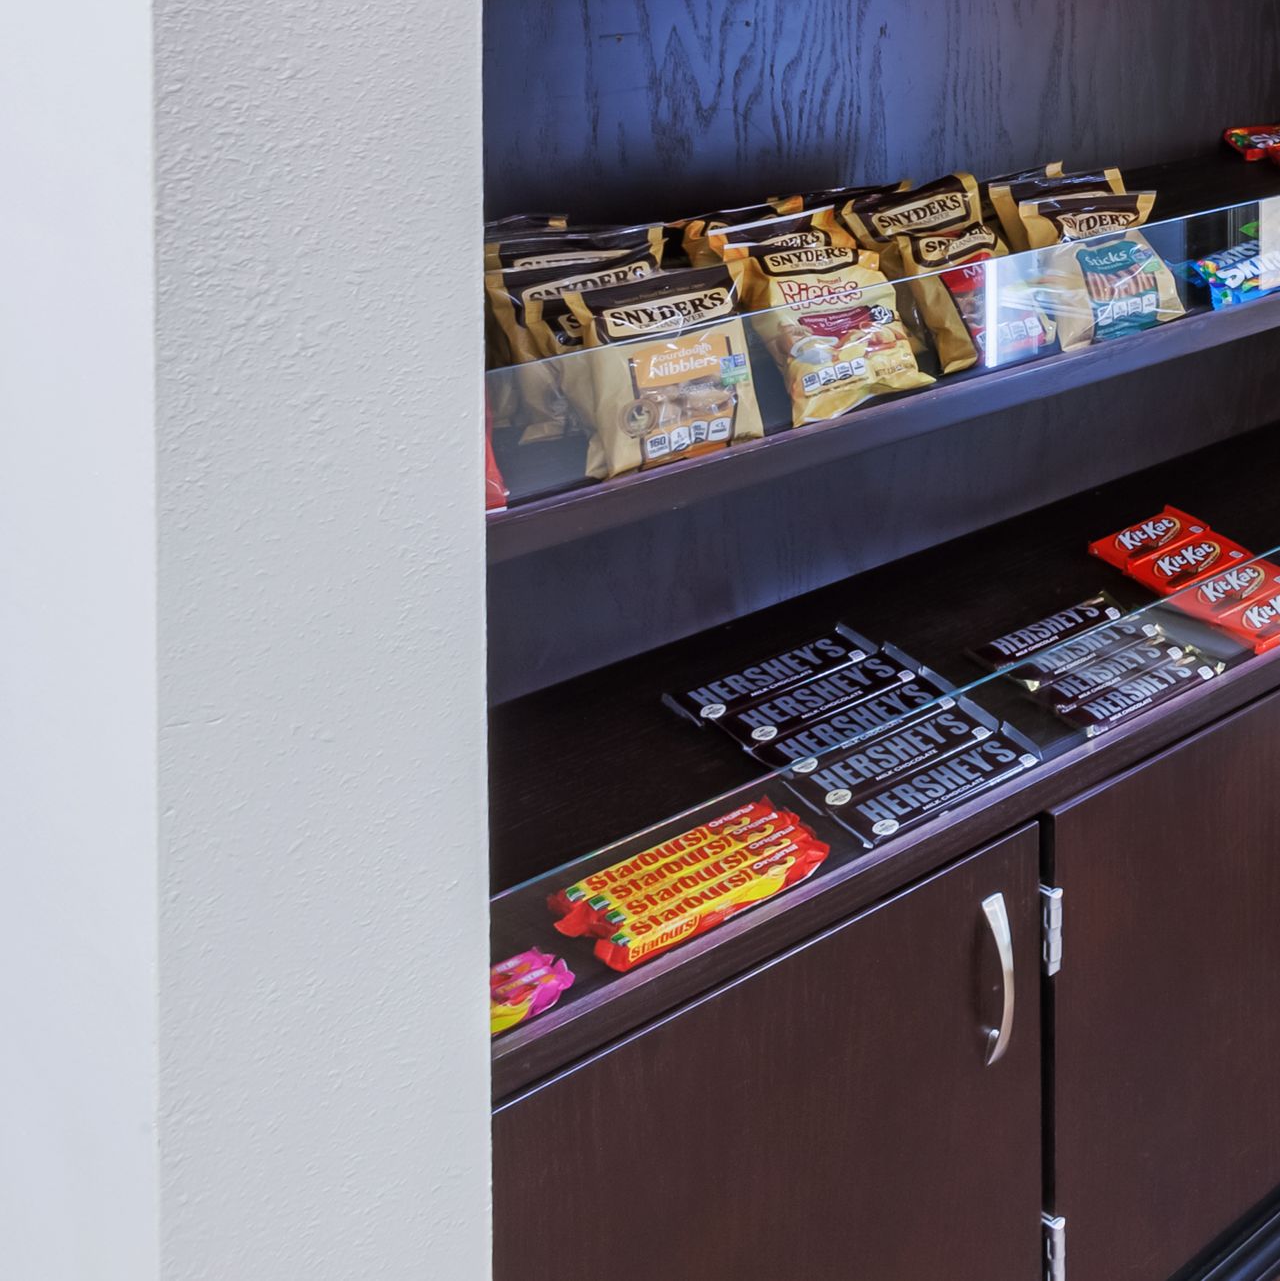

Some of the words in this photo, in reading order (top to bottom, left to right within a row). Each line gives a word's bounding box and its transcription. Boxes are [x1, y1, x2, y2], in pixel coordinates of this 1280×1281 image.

[877, 193, 962, 230] SNYDER'S
[769, 248, 850, 267] SNYDER'S
[1083, 247, 1129, 270] Sticks
[609, 291, 726, 327] SNYDER'S
[649, 354, 718, 379] Nibblers
[649, 435, 667, 446] 160
[1118, 519, 1175, 551] KitKat
[1157, 542, 1215, 577] KitKat
[1201, 567, 1259, 603] KitKat
[991, 604, 1099, 655] HERSHEY'S
[1052, 642, 1162, 698] HERSHEY'S
[737, 657, 897, 730] HERSHEY'S
[1082, 663, 1192, 720] HERSHEY'S
[809, 710, 971, 793] HERSHEY'S
[896, 749, 938, 771] CHOCOLATE
[856, 739, 1018, 823] HERSHEY'S
[922, 798, 941, 811] MILK
[942, 777, 985, 800] CHOCOLATE
[586, 826, 708, 892] Starburst
[610, 836, 732, 900] Starburst
[733, 812, 778, 836] Original
[627, 850, 749, 915] Starburst
[749, 825, 795, 850] Original
[631, 868, 753, 936] Starburst
[752, 844, 799, 870] Original
